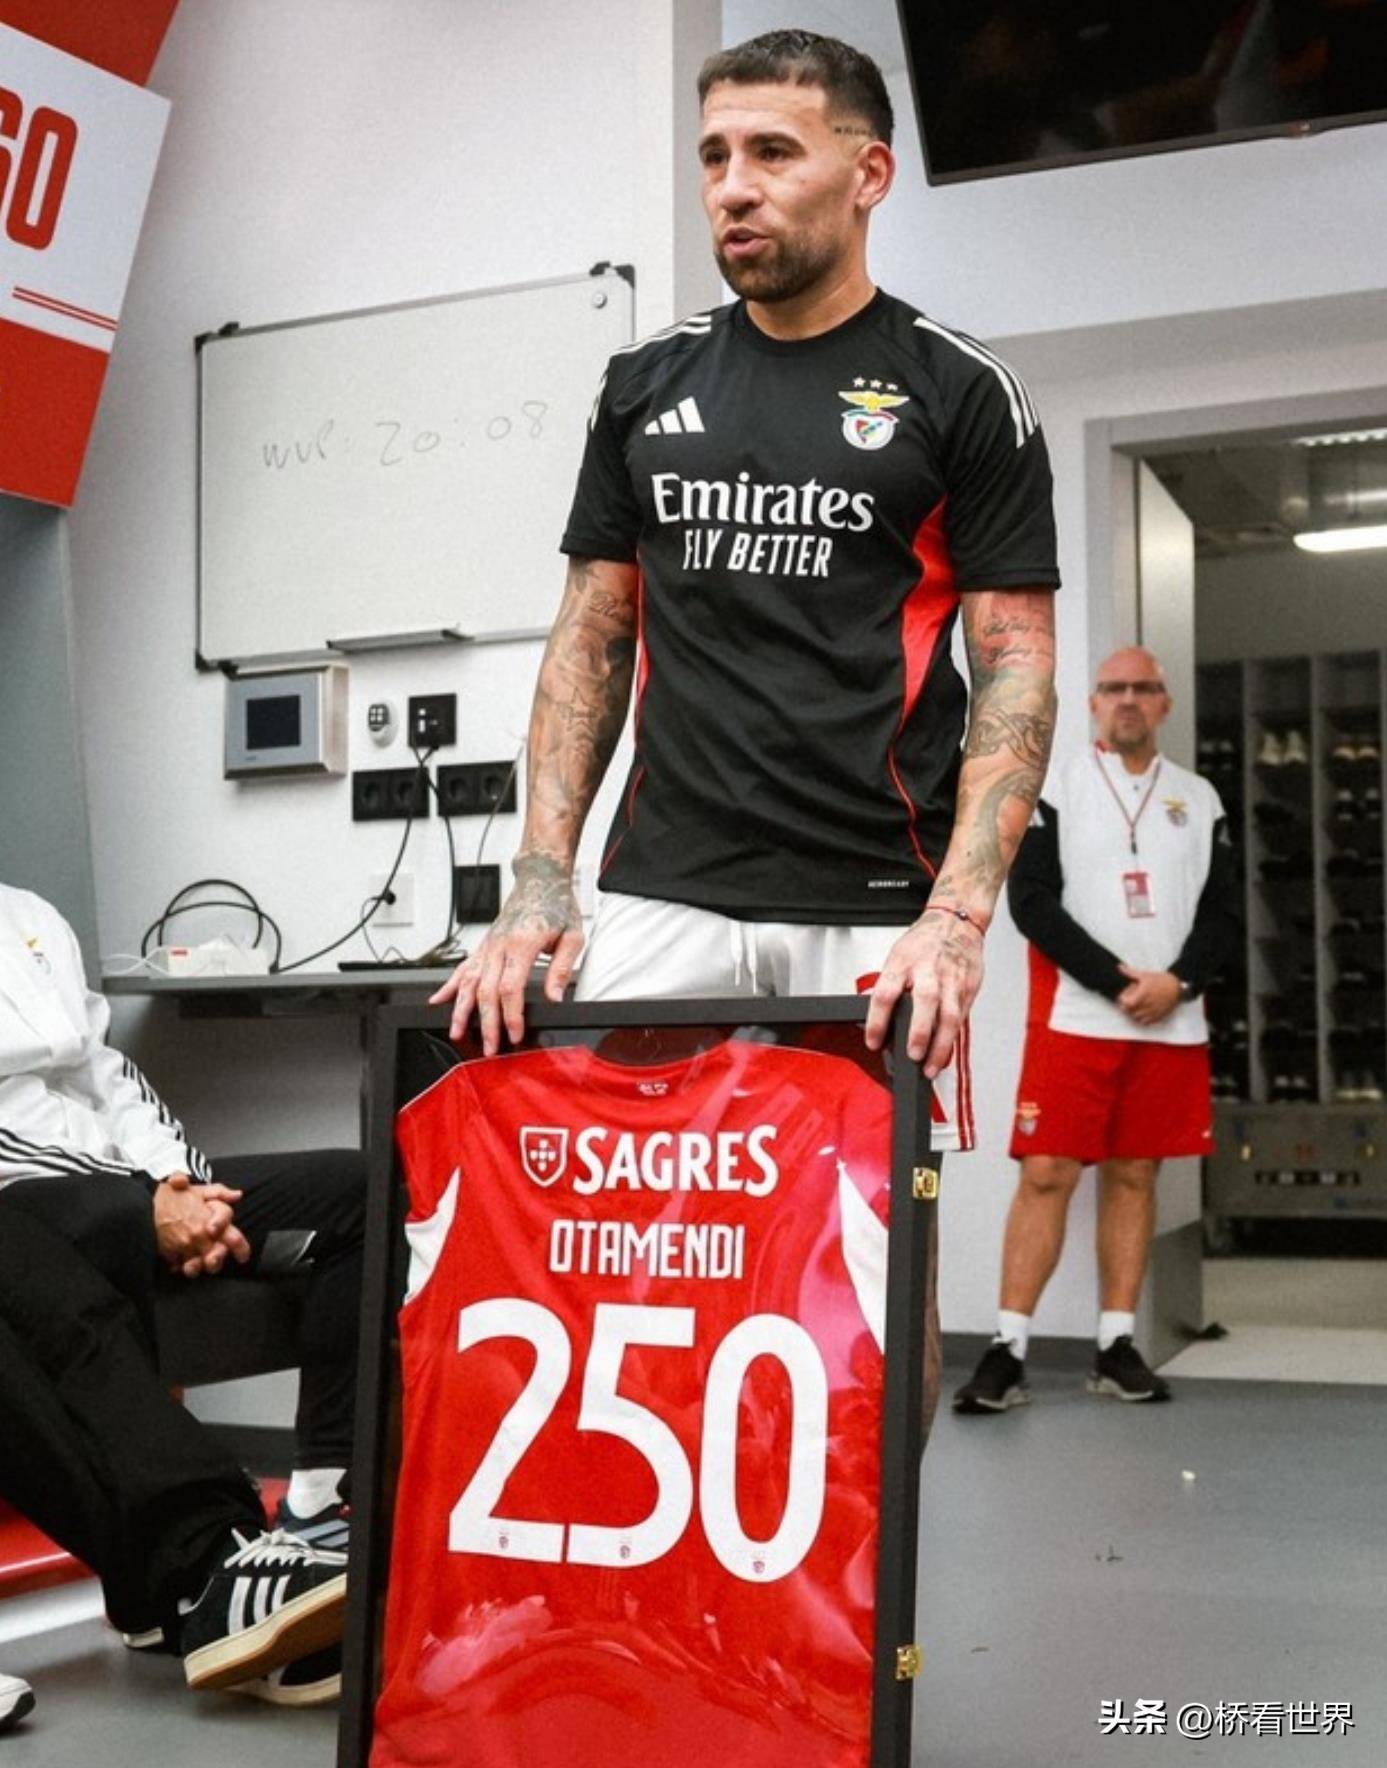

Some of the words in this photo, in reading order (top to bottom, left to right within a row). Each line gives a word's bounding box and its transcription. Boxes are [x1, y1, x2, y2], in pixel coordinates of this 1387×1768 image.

[651, 471, 875, 532] Emirates
[682, 528, 724, 571] FLY
[726, 531, 834, 578] BETTER
[572, 1124, 780, 1198] SAGRES
[549, 1218, 746, 1280] OTAMENDI
[447, 1297, 830, 1584] 250
